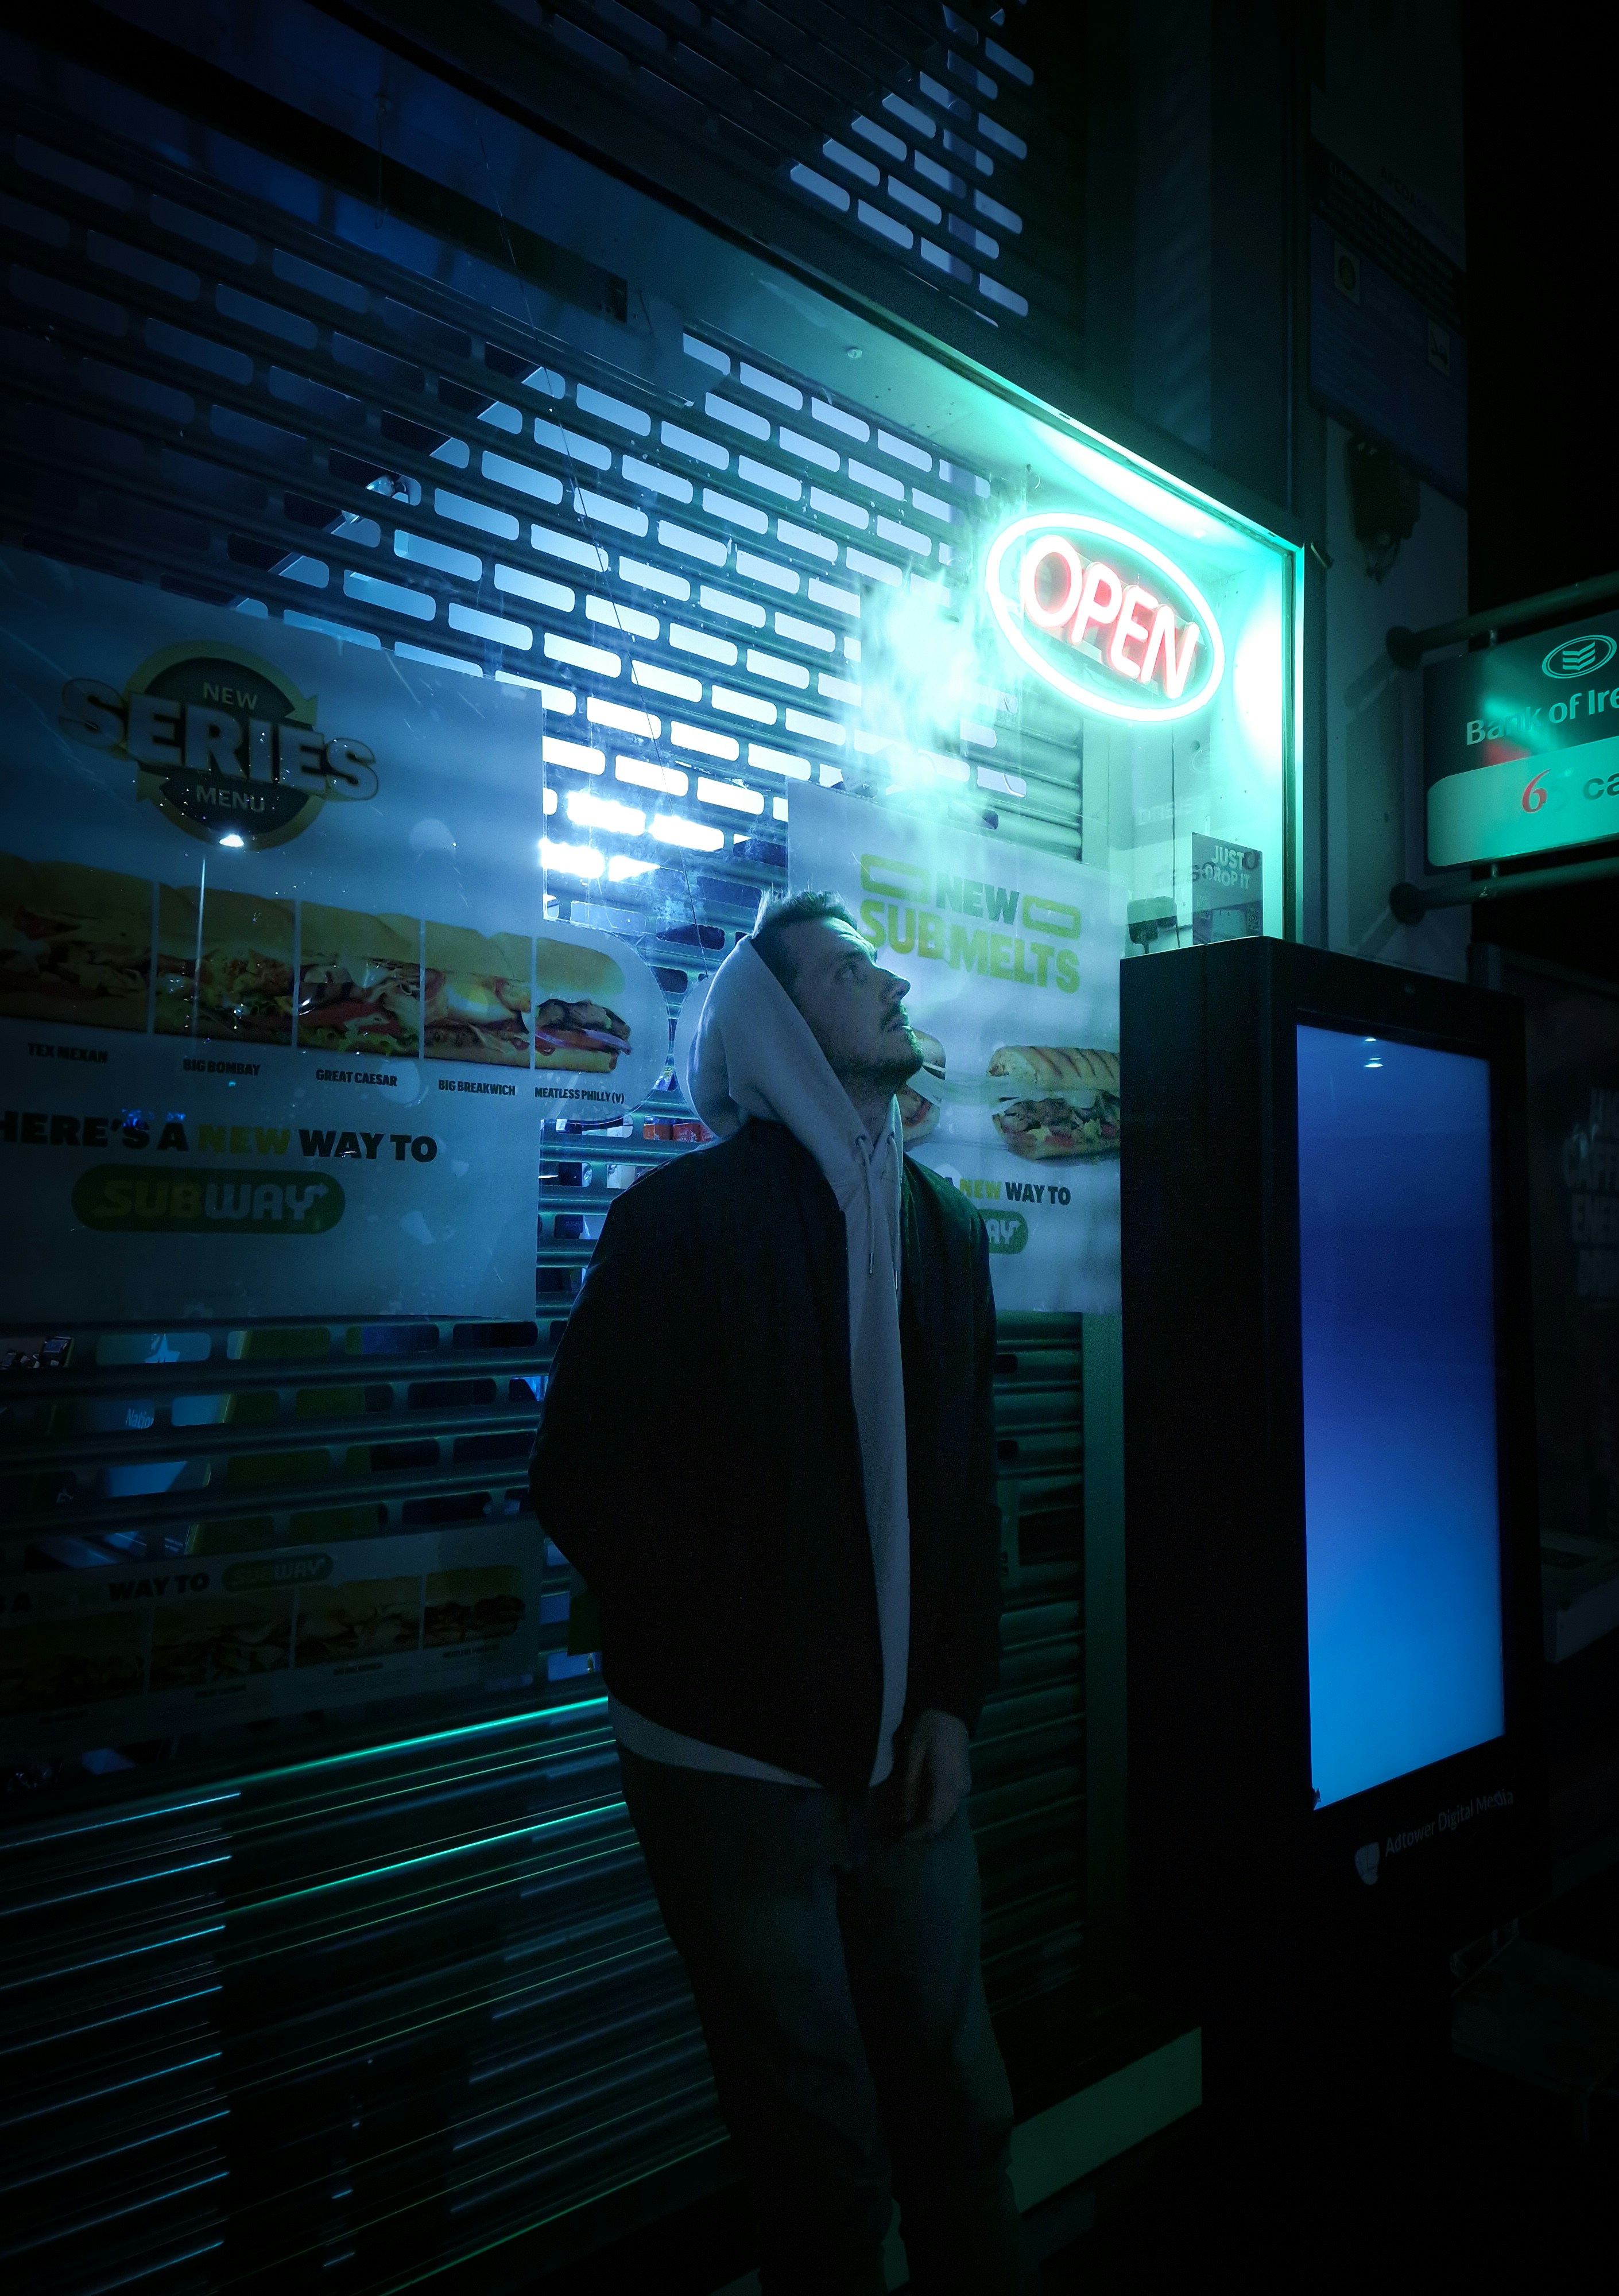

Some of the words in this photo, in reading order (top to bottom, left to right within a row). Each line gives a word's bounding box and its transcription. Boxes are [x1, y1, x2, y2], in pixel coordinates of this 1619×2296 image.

[1020, 534, 1200, 700] OPEN
[203, 681, 258, 711] NEW
[1466, 705, 1543, 746] Bank
[1549, 692, 1583, 724] of
[58, 678, 379, 801] SERIES
[196, 784, 265, 813] MENU
[1211, 845, 1245, 871] JUST
[1204, 863, 1238, 887] DROP
[1241, 872, 1251, 889] IT
[936, 871, 1020, 925] NEW
[28, 1042, 54, 1058] TEX
[57, 1045, 108, 1063] MEXAN
[183, 1058, 206, 1072] BIG
[207, 1061, 261, 1077] BOMBAY
[316, 1069, 353, 1083] GREAT
[354, 1072, 397, 1087] CAESAR
[438, 1079, 456, 1091] BIG
[457, 1080, 516, 1096] BREAKWICH
[534, 1087, 580, 1099] MEATLESS
[581, 1089, 611, 1102] PHILLY
[611, 1091, 625, 1104] (V)
[157, 1122, 189, 1152] A
[197, 1124, 291, 1155] NEW
[299, 1128, 384, 1160] WAY
[390, 1134, 437, 1163] TO
[92, 1179, 329, 1221] SUBWAY
[959, 1178, 1001, 1200] NEW
[1005, 1181, 1045, 1204] WAY
[1047, 1186, 1071, 1206] TO
[108, 1575, 171, 1602] WAY
[174, 1572, 211, 1594] TO
[231, 1557, 327, 1587] SUBWAY
[1385, 1821, 1435, 1858] Adtower
[1438, 1799, 1474, 1832] Digital
[1476, 1788, 1515, 1815] Media
